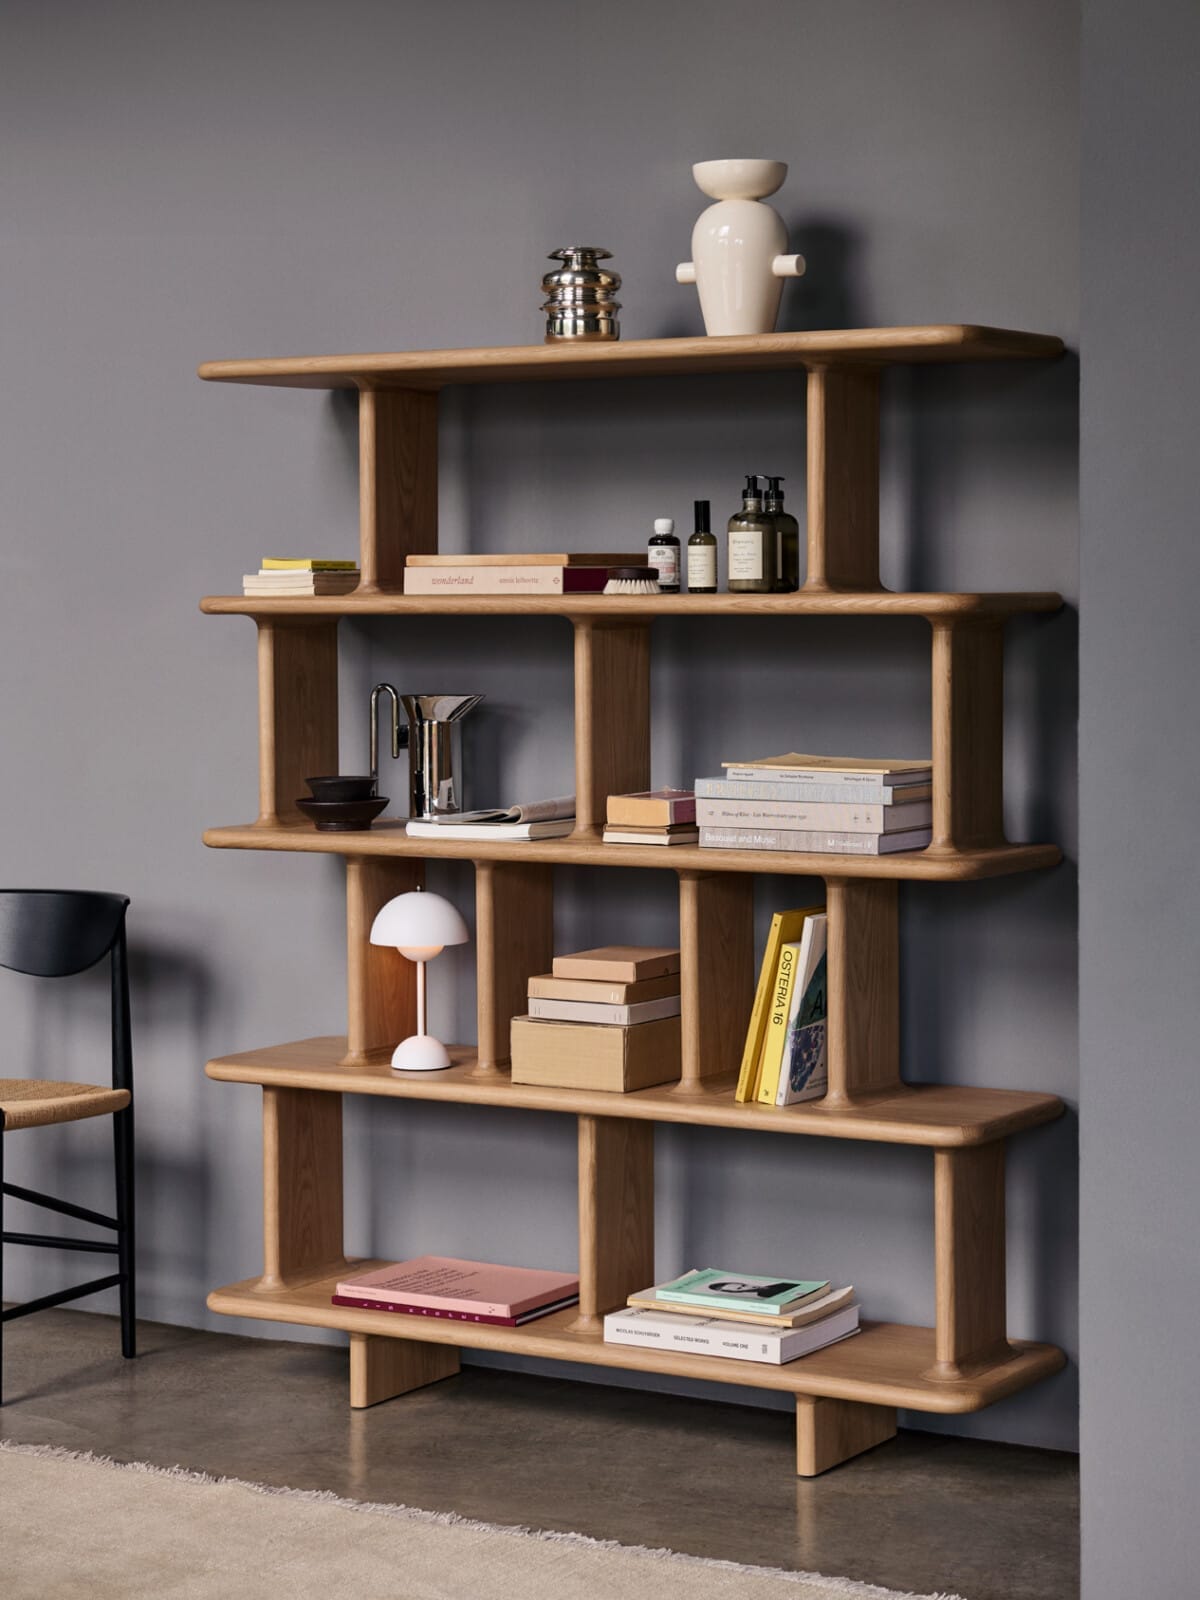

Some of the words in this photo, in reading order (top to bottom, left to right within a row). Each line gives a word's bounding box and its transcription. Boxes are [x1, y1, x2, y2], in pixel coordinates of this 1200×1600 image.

[431, 575, 475, 585] wonderland
[775, 950, 793, 1008] OSTERIA
[772, 1012, 784, 1026] 16
[673, 1335, 694, 1343] SELECTED
[694, 1337, 710, 1345] WORKS
[722, 1341, 739, 1349] VOLUME
